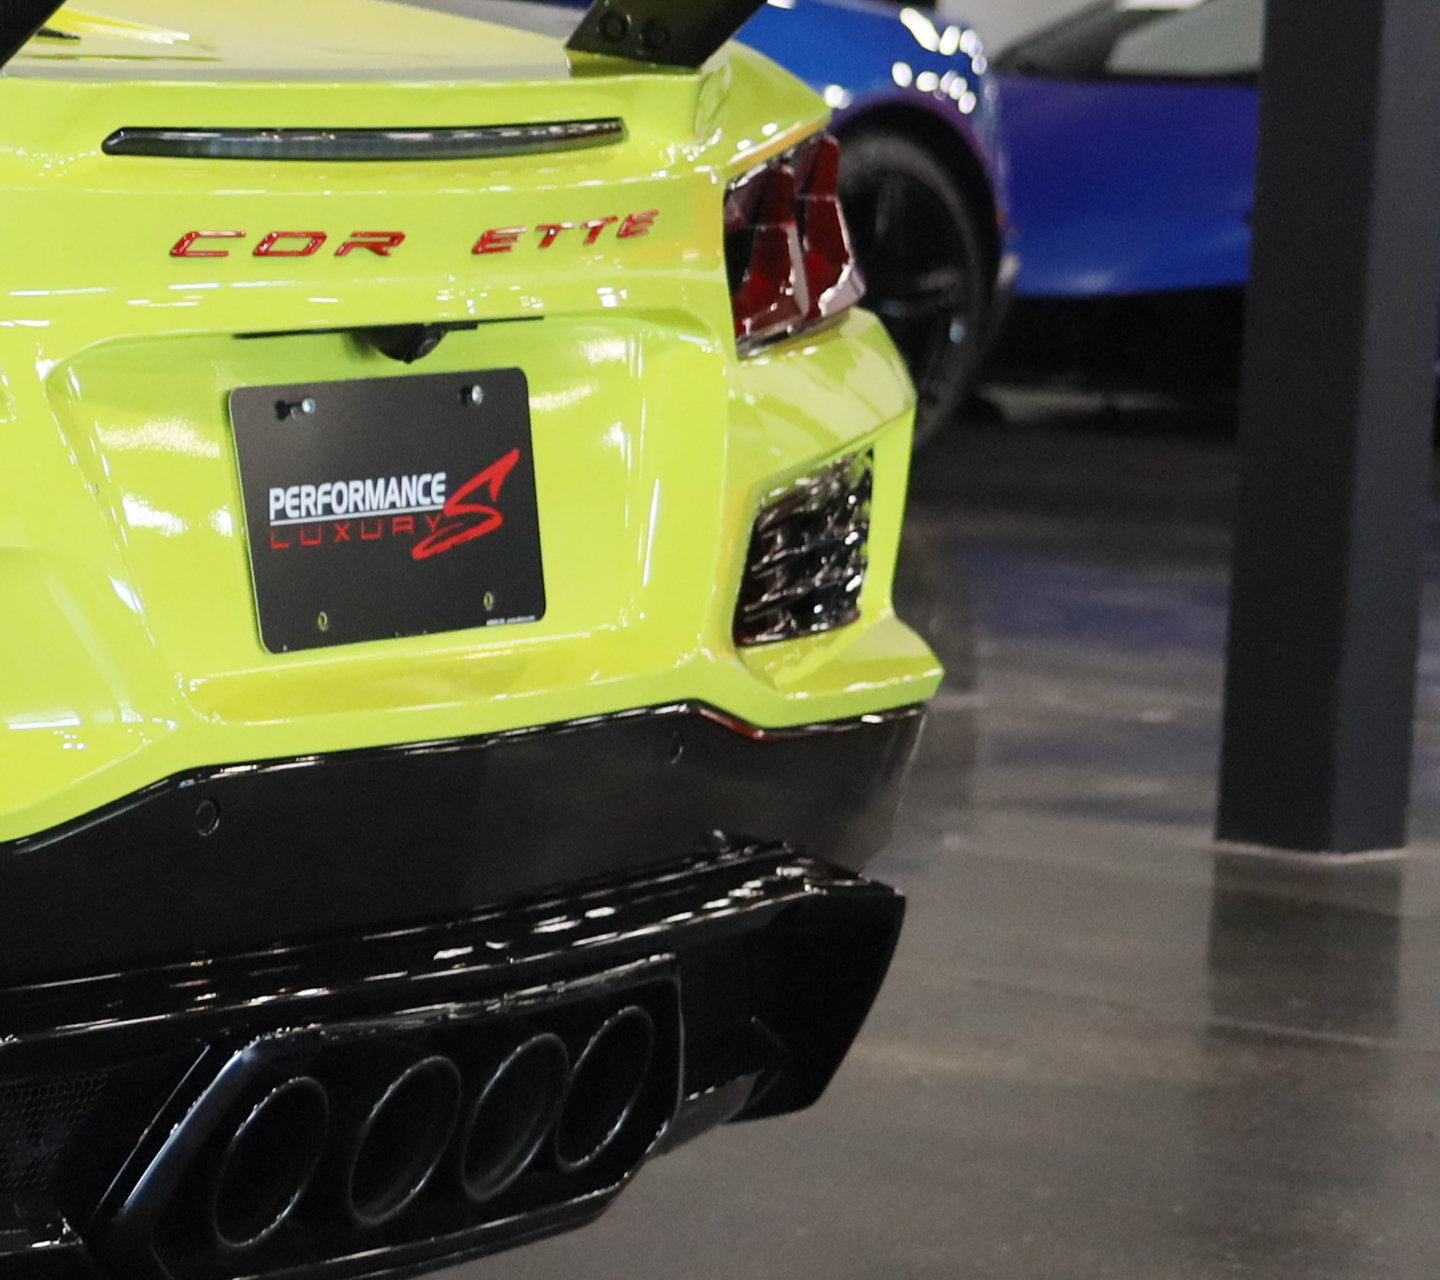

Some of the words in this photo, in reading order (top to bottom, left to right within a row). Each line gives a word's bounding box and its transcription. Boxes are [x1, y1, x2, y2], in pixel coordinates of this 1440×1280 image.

[168, 208, 659, 257] CORETTE
[268, 471, 447, 521] PERFORMANCE
[269, 512, 451, 549] LUXURY
